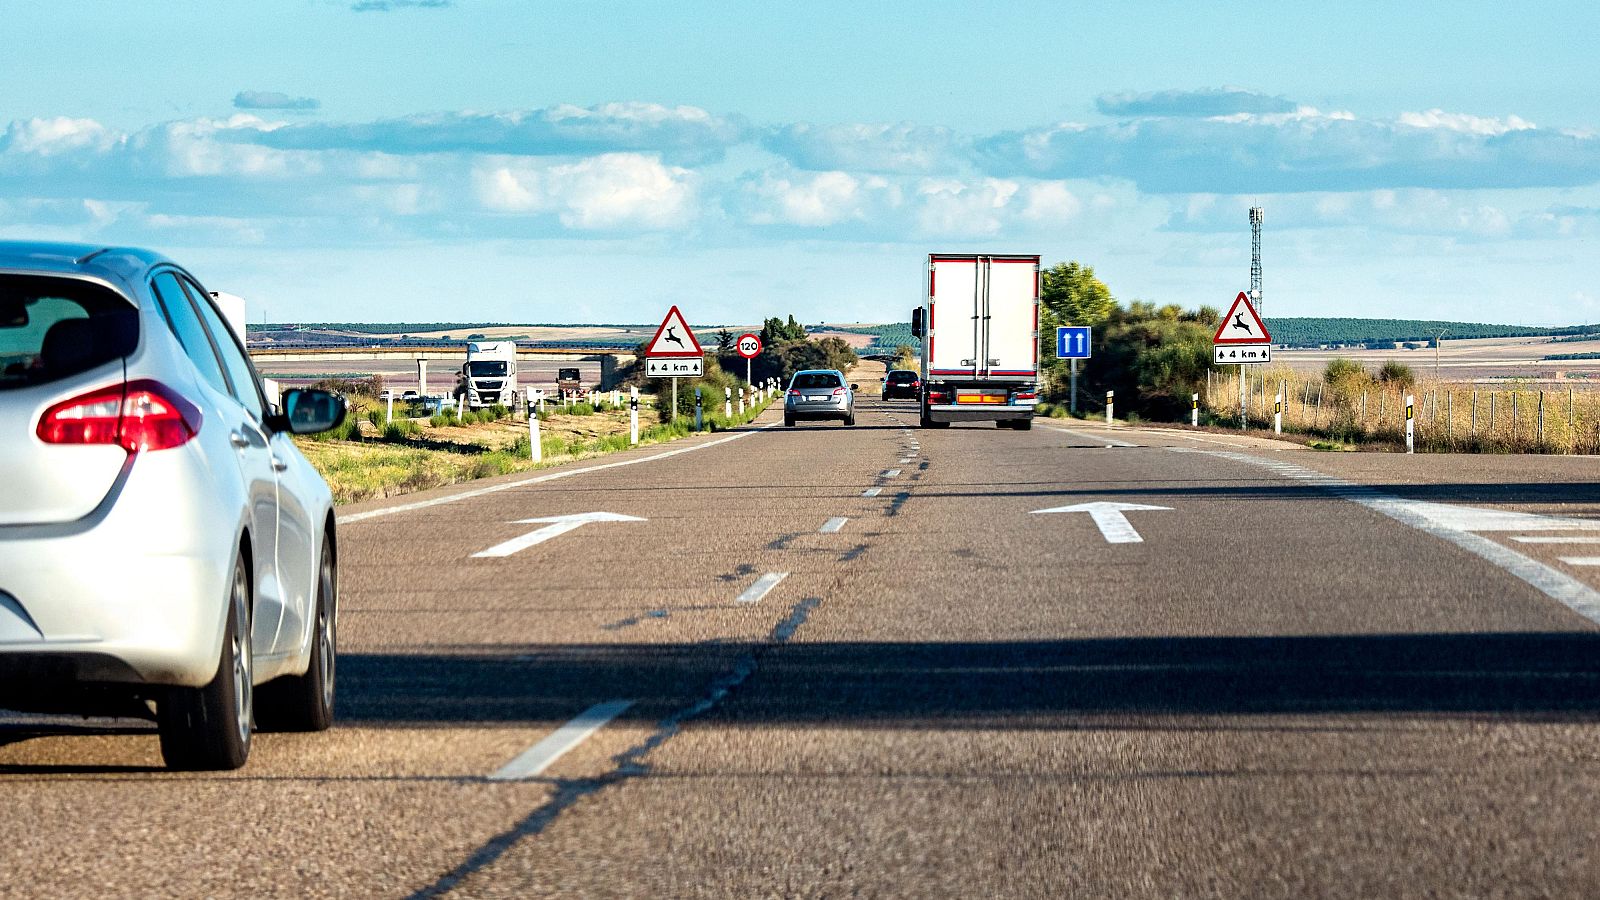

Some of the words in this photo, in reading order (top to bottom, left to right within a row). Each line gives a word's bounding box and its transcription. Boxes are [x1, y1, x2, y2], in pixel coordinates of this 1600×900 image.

[741, 342, 758, 351] 120
[1229, 350, 1236, 358] 4
[1241, 350, 1257, 358] km
[661, 363, 668, 371] 4
[673, 363, 688, 371] km
